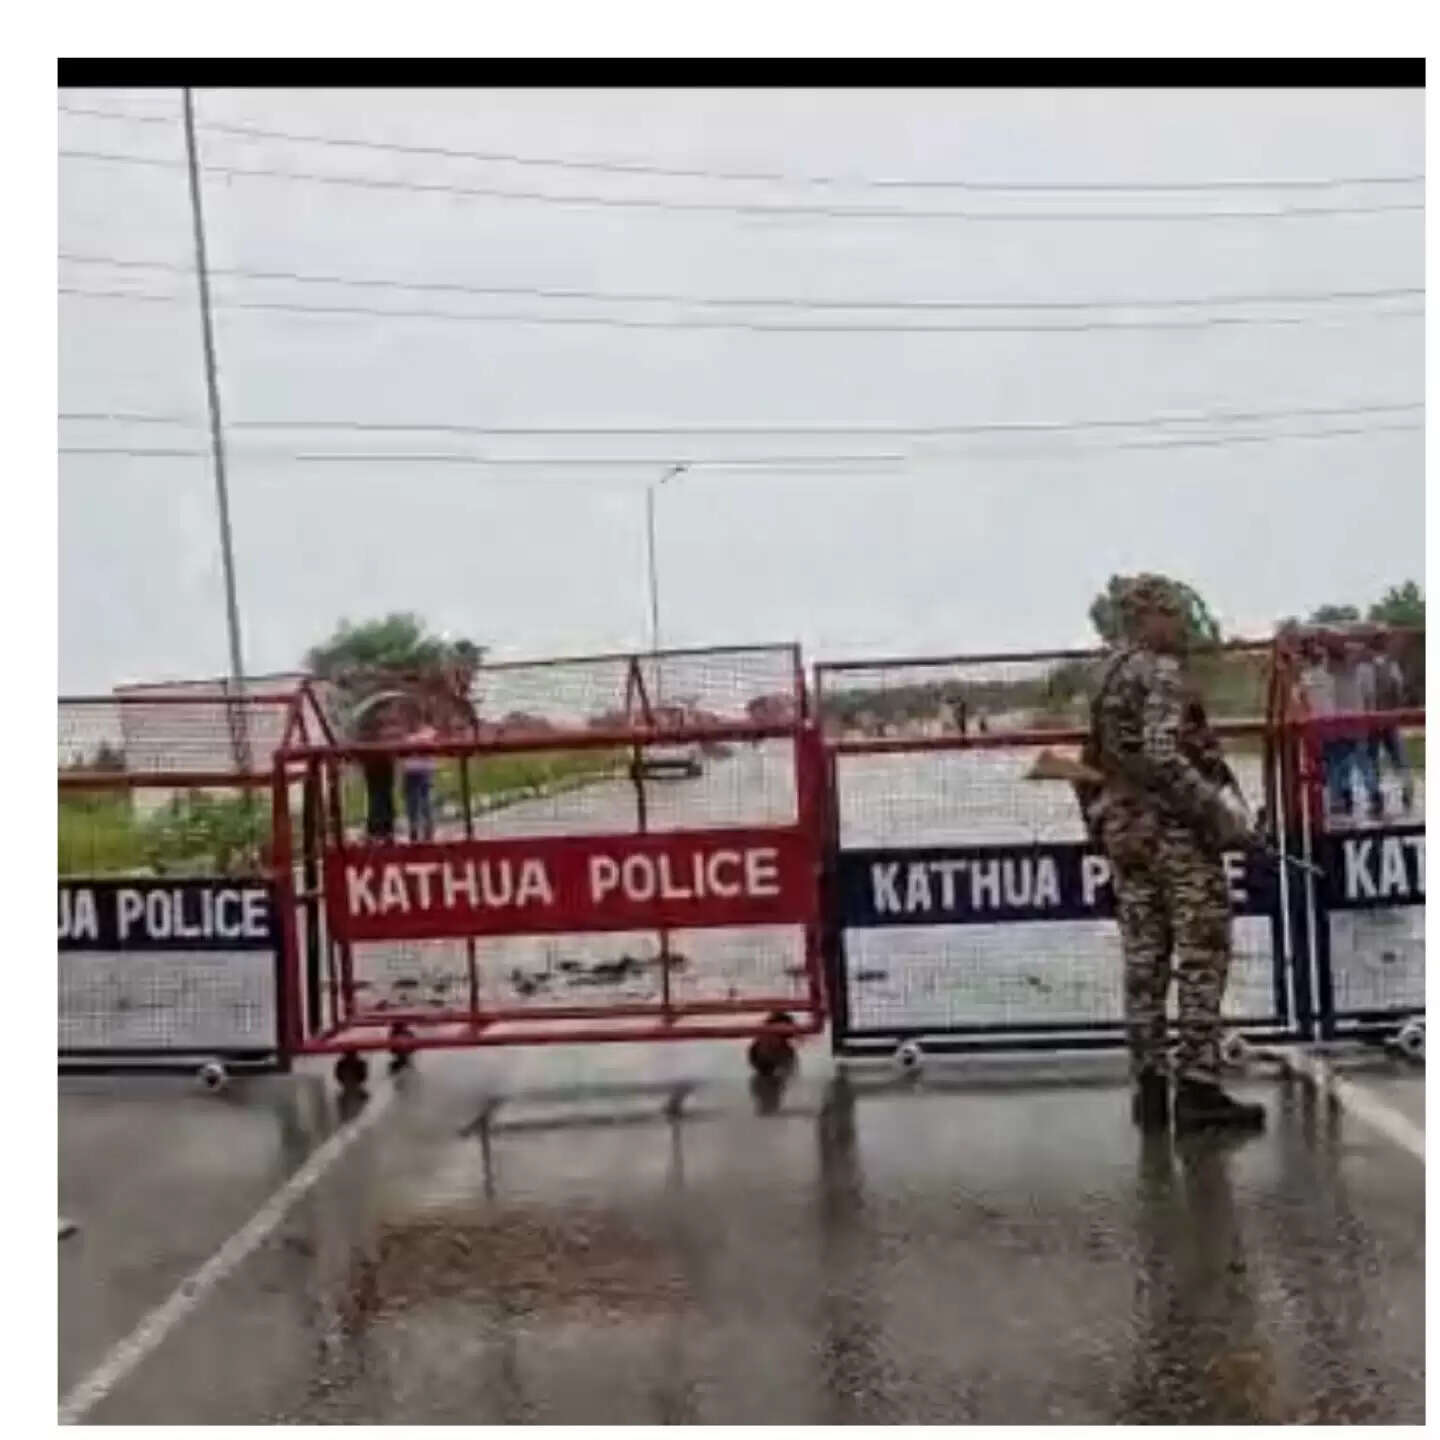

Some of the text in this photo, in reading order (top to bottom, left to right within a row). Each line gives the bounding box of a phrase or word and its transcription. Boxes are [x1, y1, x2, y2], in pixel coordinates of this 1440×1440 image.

[345, 848, 780, 916] KATHUA POLICE
[872, 857, 1060, 913] KATHUA
[1342, 837, 1425, 898] KAT
[116, 889, 270, 940] POLICE
